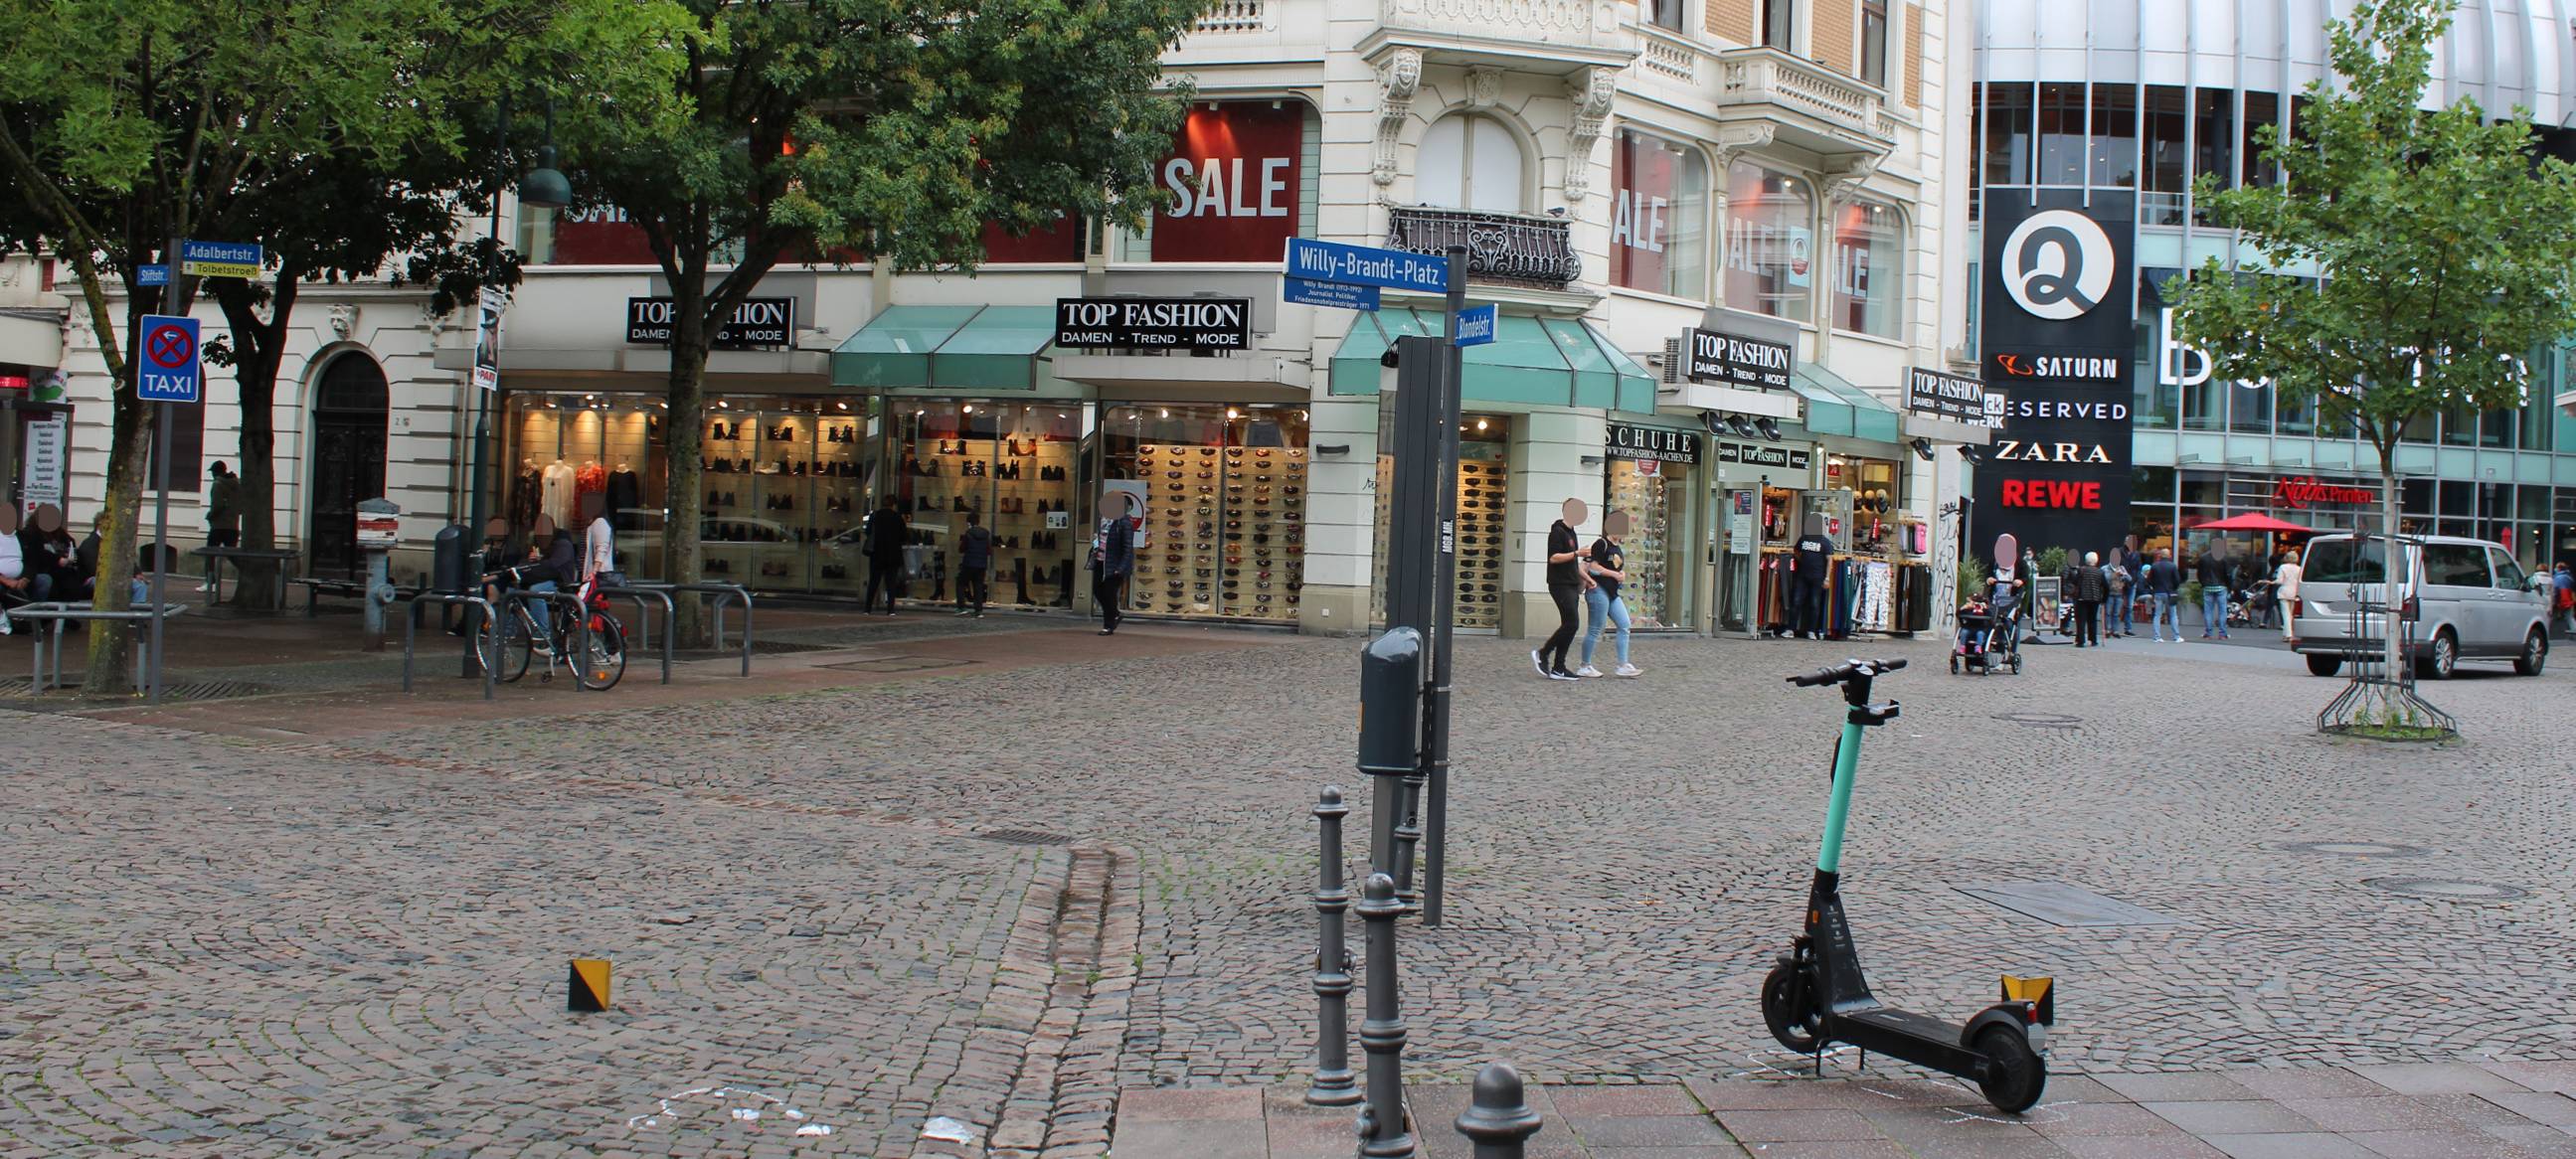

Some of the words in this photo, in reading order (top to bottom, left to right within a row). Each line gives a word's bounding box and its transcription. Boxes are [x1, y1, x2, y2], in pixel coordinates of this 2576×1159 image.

[1164, 157, 1289, 218] SALE
[1613, 188, 1667, 253] ALE
[189, 245, 255, 261] Adalbertstr.
[1728, 217, 1775, 277] ALE
[1299, 246, 1439, 285] Willy-Brandt-Platz
[1303, 280, 1316, 289] Willy
[1294, 295, 1357, 308] Friedensnobelpreisträger
[1063, 303, 1117, 326] TOP
[1122, 303, 1242, 327] FASHION
[1459, 314, 1490, 339] Blondelstr.
[746, 330, 783, 341] MODE
[1062, 332, 1113, 344] DAMEN
[1196, 333, 1239, 345] MODE
[1696, 334, 1726, 360] TOP
[1729, 339, 1789, 371] FASHION
[1695, 362, 1723, 376] DAMEN
[1765, 373, 1787, 386] MODE
[2036, 357, 2117, 379] SATURN
[144, 374, 192, 394] TAXI
[1914, 372, 1937, 394] TOP
[1939, 377, 1983, 403] FASHION
[1913, 397, 1934, 409] DAMEN
[1965, 405, 1982, 416] MODE
[2006, 401, 2127, 419] ESERVED
[1606, 425, 1692, 452] SCHUHE
[1744, 448, 1756, 460] TOP
[1757, 450, 1785, 463] FASHION
[1995, 440, 2113, 463] ZARA
[2002, 479, 2101, 510] REWE
[2329, 485, 2375, 503] Printen
